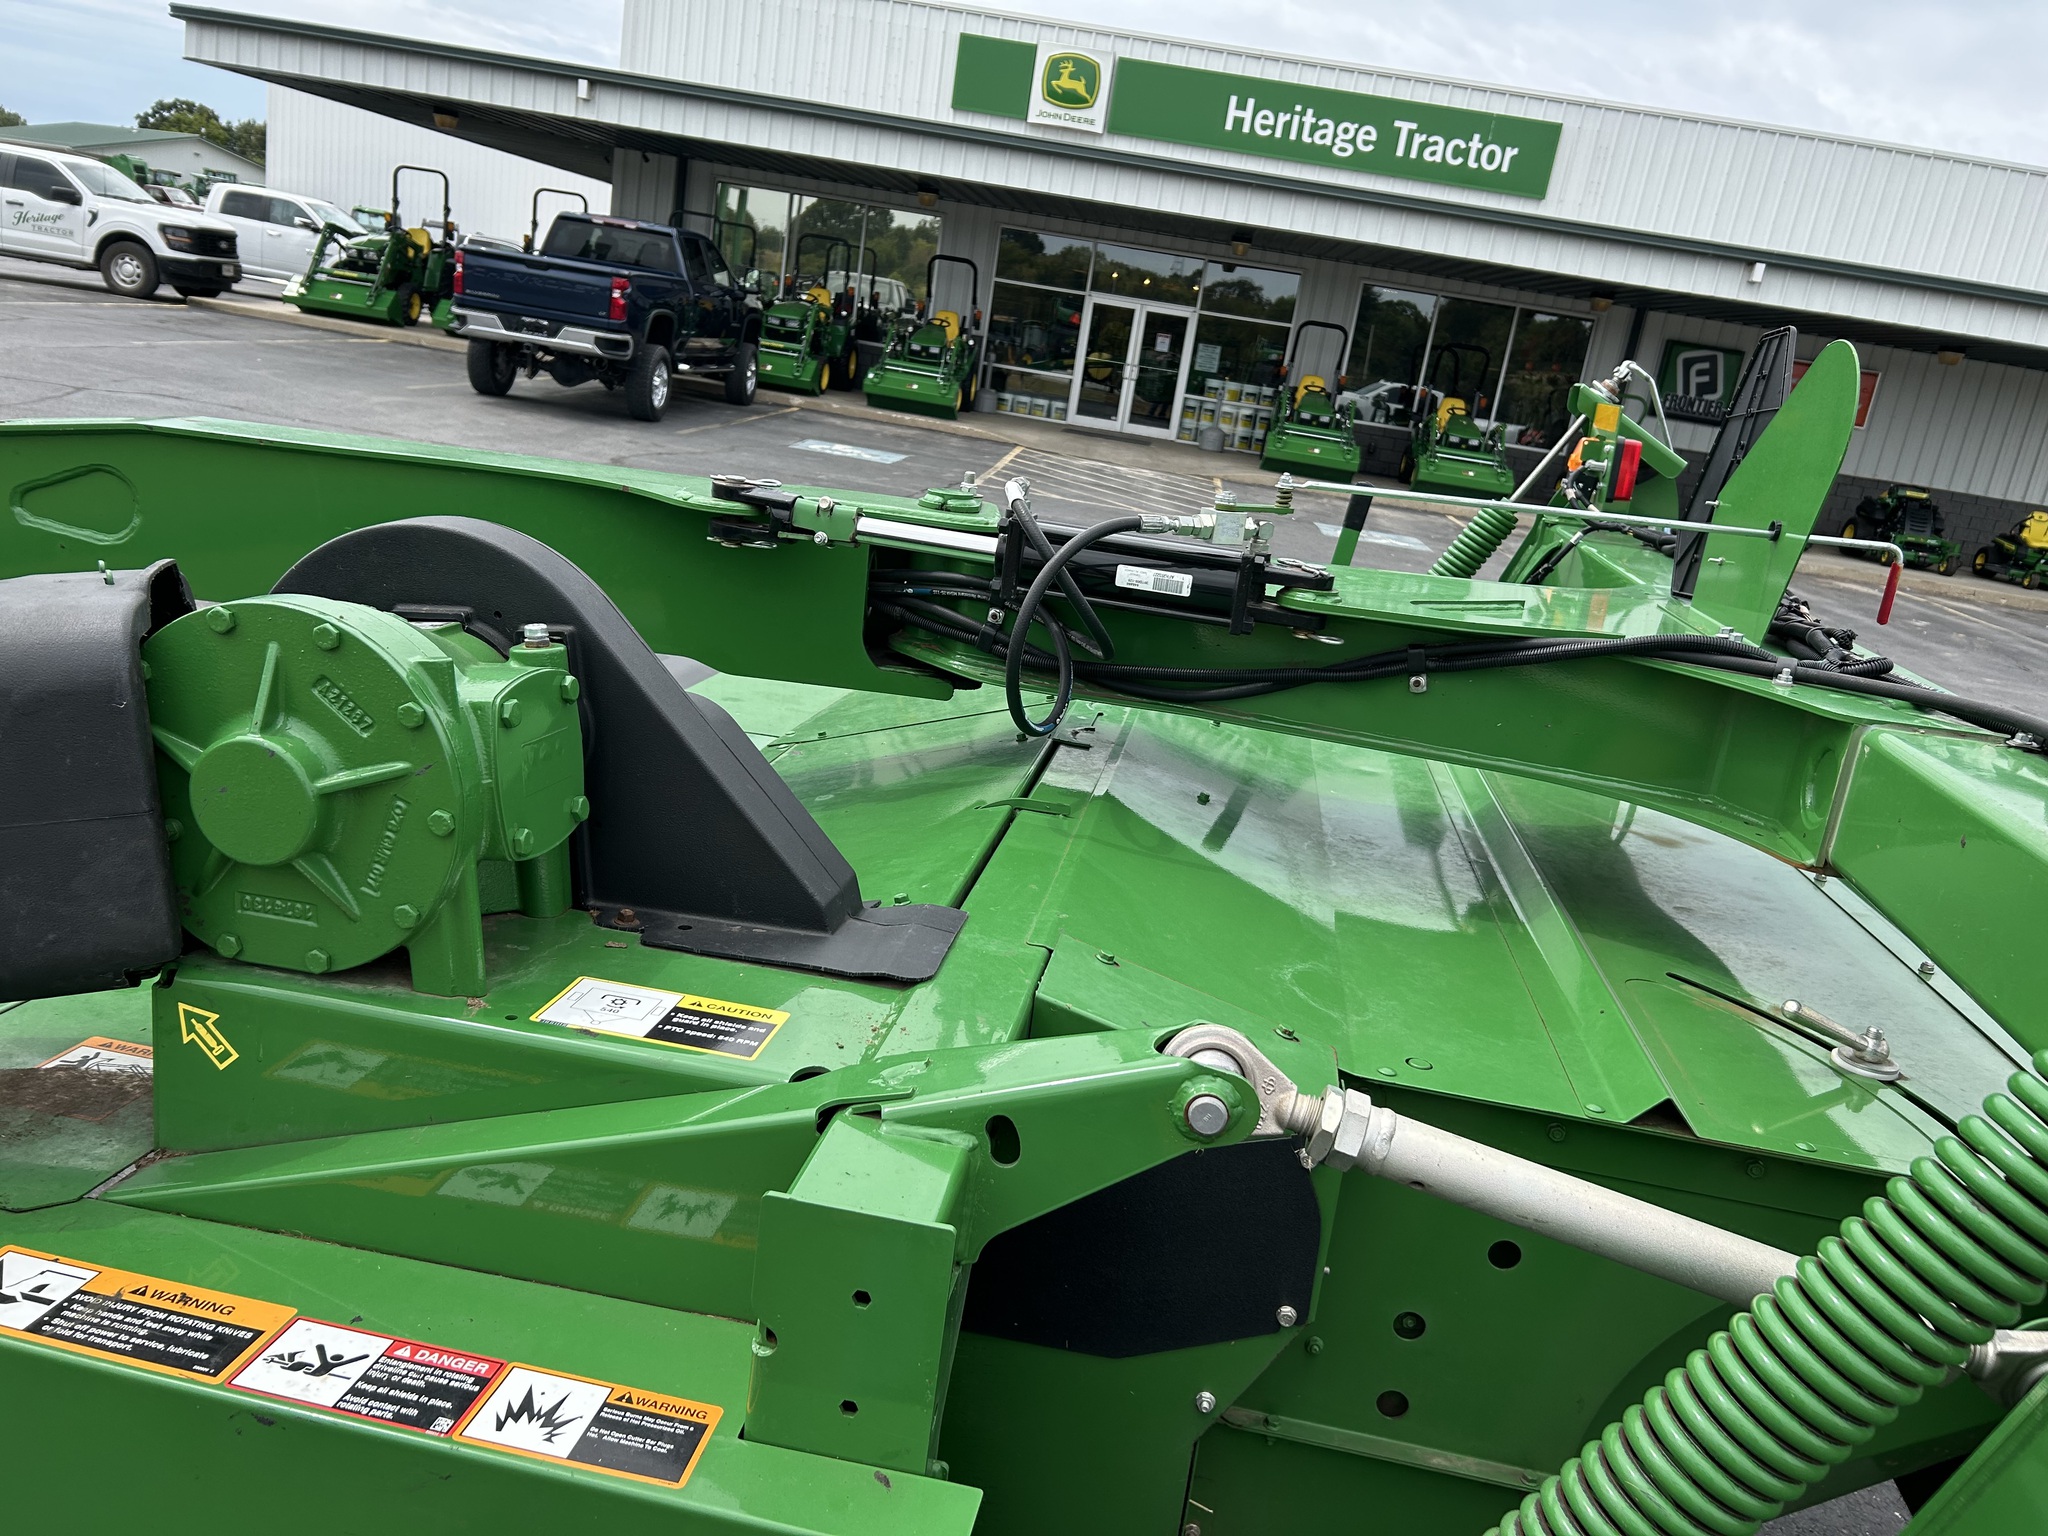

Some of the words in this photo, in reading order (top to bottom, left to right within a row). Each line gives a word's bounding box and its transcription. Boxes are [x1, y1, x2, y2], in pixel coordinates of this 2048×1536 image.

[1035, 109, 1063, 121] JOHN
[1063, 112, 1097, 126] DEERE
[1224, 95, 1378, 157] Heritage
[1393, 120, 1519, 173] Tractor
[12, 210, 64, 226] Heritage
[31, 224, 75, 236] TRACTOR
[600, 1006, 620, 1014] 540
[706, 1003, 773, 1020] CAUTION
[671, 1017, 700, 1026] guard
[709, 1023, 738, 1033] place.
[676, 1012, 701, 1021] Keep
[713, 1019, 747, 1030] shields
[747, 1025, 767, 1034] and
[663, 1025, 685, 1033] PTO
[735, 1038, 760, 1047] RPM
[150, 1289, 236, 1316] WARNING
[60, 1310, 100, 1324] machine
[110, 1322, 149, 1336] running.
[70, 1303, 94, 1315] Keep
[95, 1309, 124, 1321] hands
[123, 1315, 144, 1325] and
[143, 1319, 163, 1330] feet
[162, 1323, 187, 1336] away
[187, 1330, 214, 1341] while
[71, 1293, 103, 1304] AVOID
[102, 1300, 140, 1313] INJURY
[137, 1307, 165, 1320] FROM
[166, 1313, 216, 1331] ROTATING
[215, 1325, 254, 1339] KNIVES
[50, 1317, 75, 1327] Shut
[74, 1322, 91, 1332] off
[87, 1328, 119, 1339] power
[119, 1333, 129, 1341] to
[129, 1336, 165, 1351] service,
[166, 1344, 210, 1360] lubricate
[53, 1327, 75, 1337] fold
[72, 1331, 89, 1340] for
[87, 1335, 133, 1351] transport.
[378, 1356, 435, 1374] Entanglement
[433, 1367, 443, 1376] in
[442, 1370, 476, 1384] rotating
[414, 1349, 490, 1375] DANGER
[372, 1362, 409, 1376] driveline
[424, 1374, 450, 1385] cause
[448, 1380, 480, 1392] serious
[401, 1376, 426, 1388] death.
[342, 1393, 370, 1403] Avoid
[367, 1400, 401, 1412] contact
[399, 1406, 419, 1417] with
[354, 1380, 378, 1392] Keep
[376, 1386, 390, 1394] all
[388, 1389, 420, 1401] shields
[418, 1394, 428, 1403] in
[427, 1397, 453, 1409] place.
[336, 1400, 371, 1415] rotating
[368, 1408, 394, 1420] parts.
[603, 1406, 625, 1416] Serious
[625, 1411, 643, 1420] Burns
[643, 1415, 656, 1424] May
[655, 1418, 675, 1427] Occur
[673, 1422, 690, 1430] From
[636, 1396, 708, 1420] WARNING
[599, 1411, 623, 1421] Release
[629, 1418, 641, 1426] Hot
[640, 1420, 675, 1433] Pressurized
[599, 1427, 611, 1435] Not
[610, 1430, 627, 1439] Open
[627, 1434, 646, 1443] Cutter
[656, 1440, 675, 1450] Plugs
[602, 1435, 620, 1443] Allow
[619, 1438, 644, 1449] Machine
